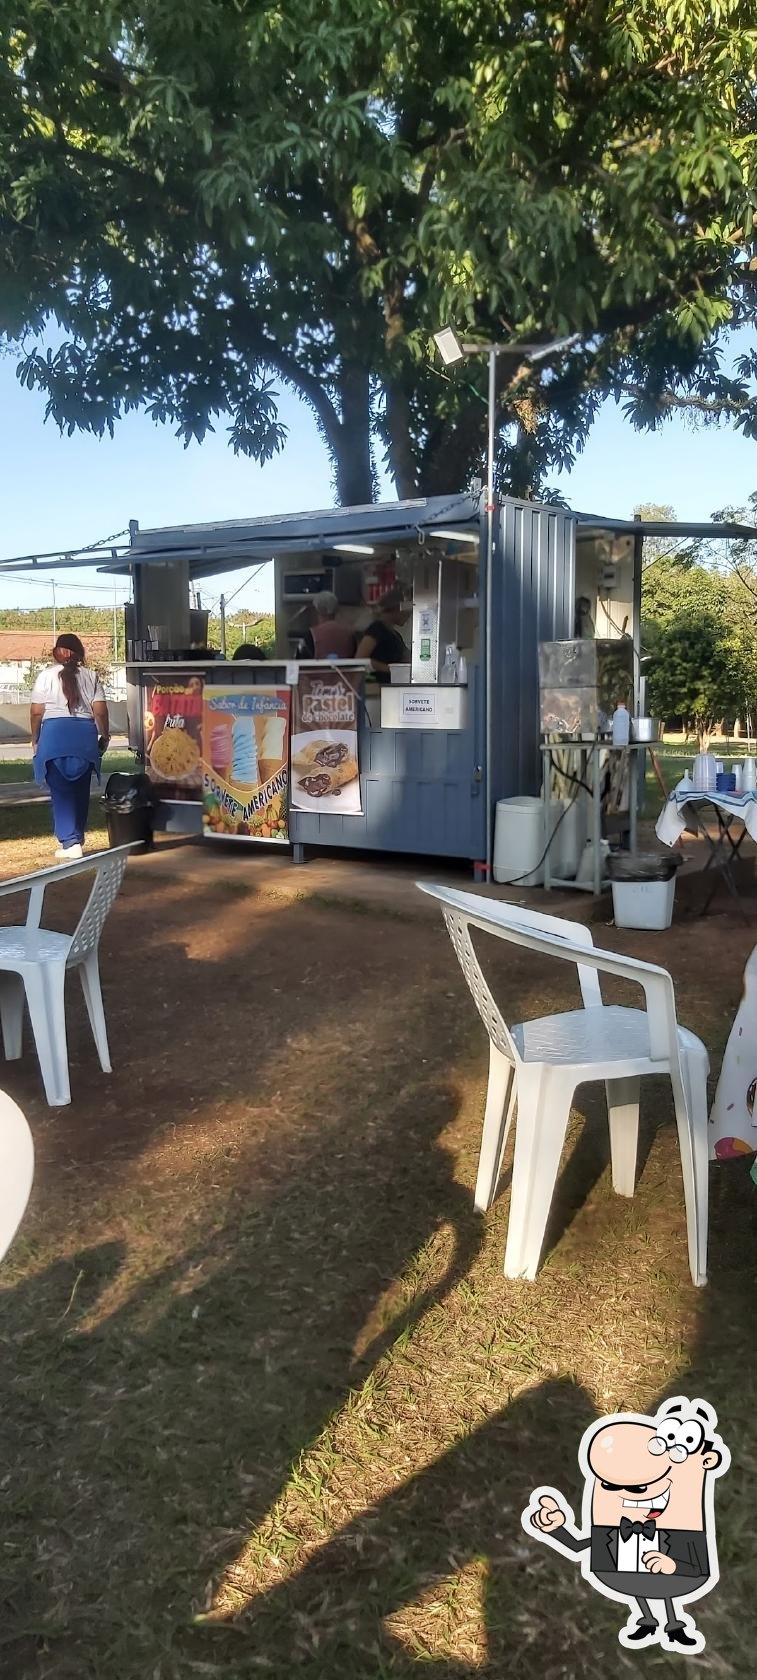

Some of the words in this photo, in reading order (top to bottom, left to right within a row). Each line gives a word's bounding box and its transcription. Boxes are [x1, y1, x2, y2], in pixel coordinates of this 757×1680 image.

[209, 696, 236, 711] Sabor
[238, 695, 249, 709] de
[302, 692, 355, 713] Pastel
[203, 773, 237, 818] SORVETE
[242, 768, 288, 822] AMERICANO
